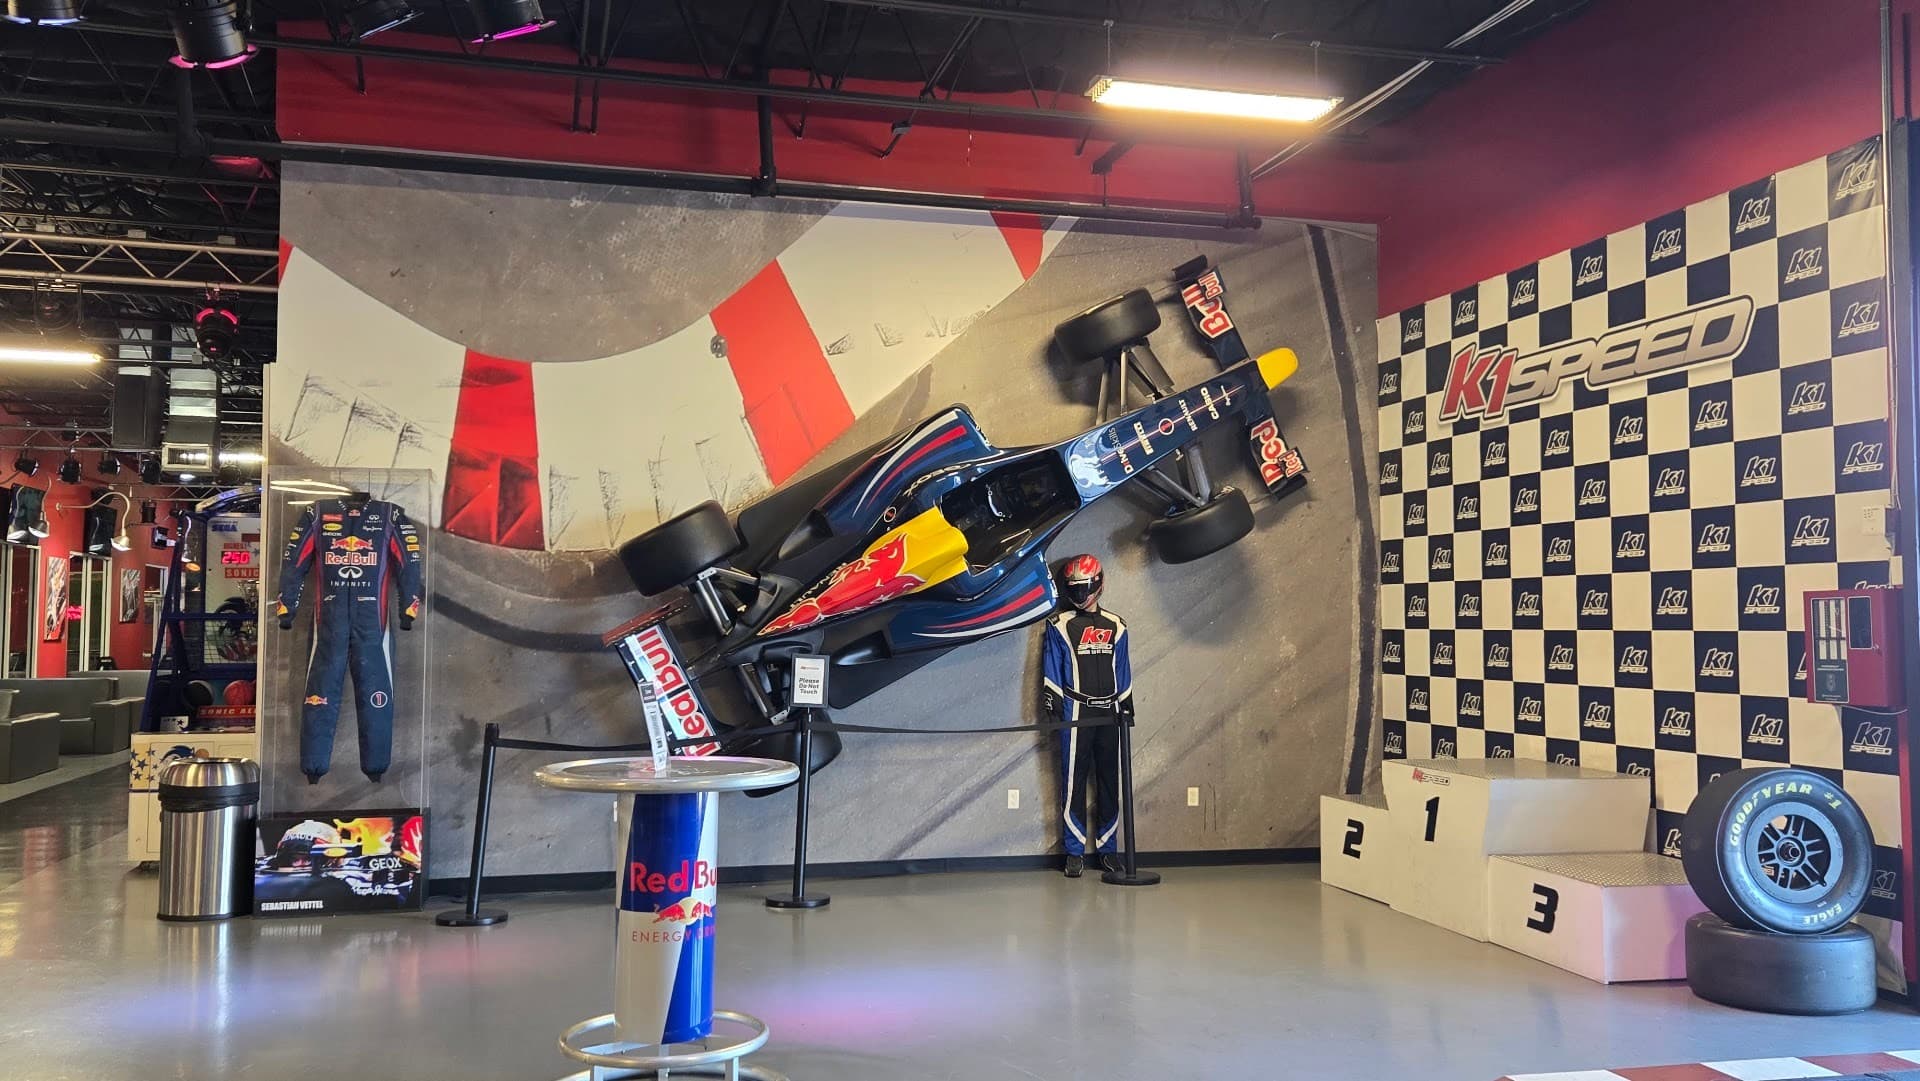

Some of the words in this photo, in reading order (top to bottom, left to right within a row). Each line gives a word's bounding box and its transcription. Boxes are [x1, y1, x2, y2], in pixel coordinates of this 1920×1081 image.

[1839, 161, 1873, 190] K1
[1834, 180, 1875, 201] SPEED
[1738, 196, 1770, 225] K1
[1735, 215, 1771, 233] SPEED
[1653, 228, 1681, 254] K1
[1578, 255, 1603, 279] K1
[1787, 247, 1822, 275] K1
[1198, 271, 1225, 300] Bull
[1784, 266, 1822, 284] SPEED
[1513, 279, 1535, 300] K1
[1181, 283, 1234, 339] Bull
[1841, 301, 1880, 329] K1
[1838, 321, 1880, 338] SPEED
[1439, 342, 1517, 419] K1
[1503, 297, 1753, 403] SPEED
[1200, 386, 1220, 420] CASIO
[1791, 381, 1826, 407] K1
[1178, 399, 1198, 432] RENAULT
[1697, 400, 1727, 424] K1
[1787, 402, 1826, 415] SPEED
[1616, 416, 1643, 438] K1
[1694, 419, 1728, 431] SPEED
[1546, 429, 1569, 450] K1
[1279, 450, 1304, 478] Red
[1845, 442, 1883, 467] K1
[1744, 456, 1776, 479] K1
[1842, 463, 1884, 475] SPEED
[1581, 479, 1605, 499] K1
[1656, 468, 1685, 490] K1
[1741, 476, 1776, 487] SPEED
[1516, 488, 1537, 507] K1
[1700, 524, 1730, 546] K1
[1794, 515, 1829, 539] K1
[1487, 542, 1507, 561] K1
[1548, 537, 1571, 556] K1
[1618, 531, 1645, 552] K1
[1697, 544, 1731, 553] SPEED
[1791, 537, 1830, 547] SPEED
[221, 551, 251, 565] 250
[325, 551, 350, 565] Red
[351, 551, 378, 566] Bull
[226, 568, 260, 578] SONIC
[1517, 592, 1539, 610] K1
[1583, 589, 1608, 609] K1
[1659, 587, 1687, 608] K1
[1746, 584, 1779, 607] K1
[1744, 606, 1780, 614] SPEED
[1080, 626, 1113, 645] K1
[1550, 645, 1573, 664] K1
[1621, 646, 1647, 667] K1
[1703, 648, 1733, 670] K1
[1700, 669, 1734, 677] SPEED
[1519, 697, 1541, 716] K1
[1586, 701, 1611, 722] K1
[1662, 707, 1690, 729] K1
[1750, 714, 1783, 738] K1
[1747, 736, 1784, 745] SPEED
[1853, 722, 1891, 747] K1
[1849, 745, 1892, 755] SPEED
[1823, 791, 1843, 810] #1
[1424, 796, 1440, 842] 1
[1342, 818, 1364, 859] 2
[369, 857, 402, 871] GEOX
[630, 860, 689, 893] Red
[261, 901, 299, 911] SEBASTIAN
[299, 900, 324, 909] VETTEL
[1526, 883, 1560, 934] 3
[1803, 902, 1843, 925] EAGLE
[632, 930, 692, 943] ENERGY
